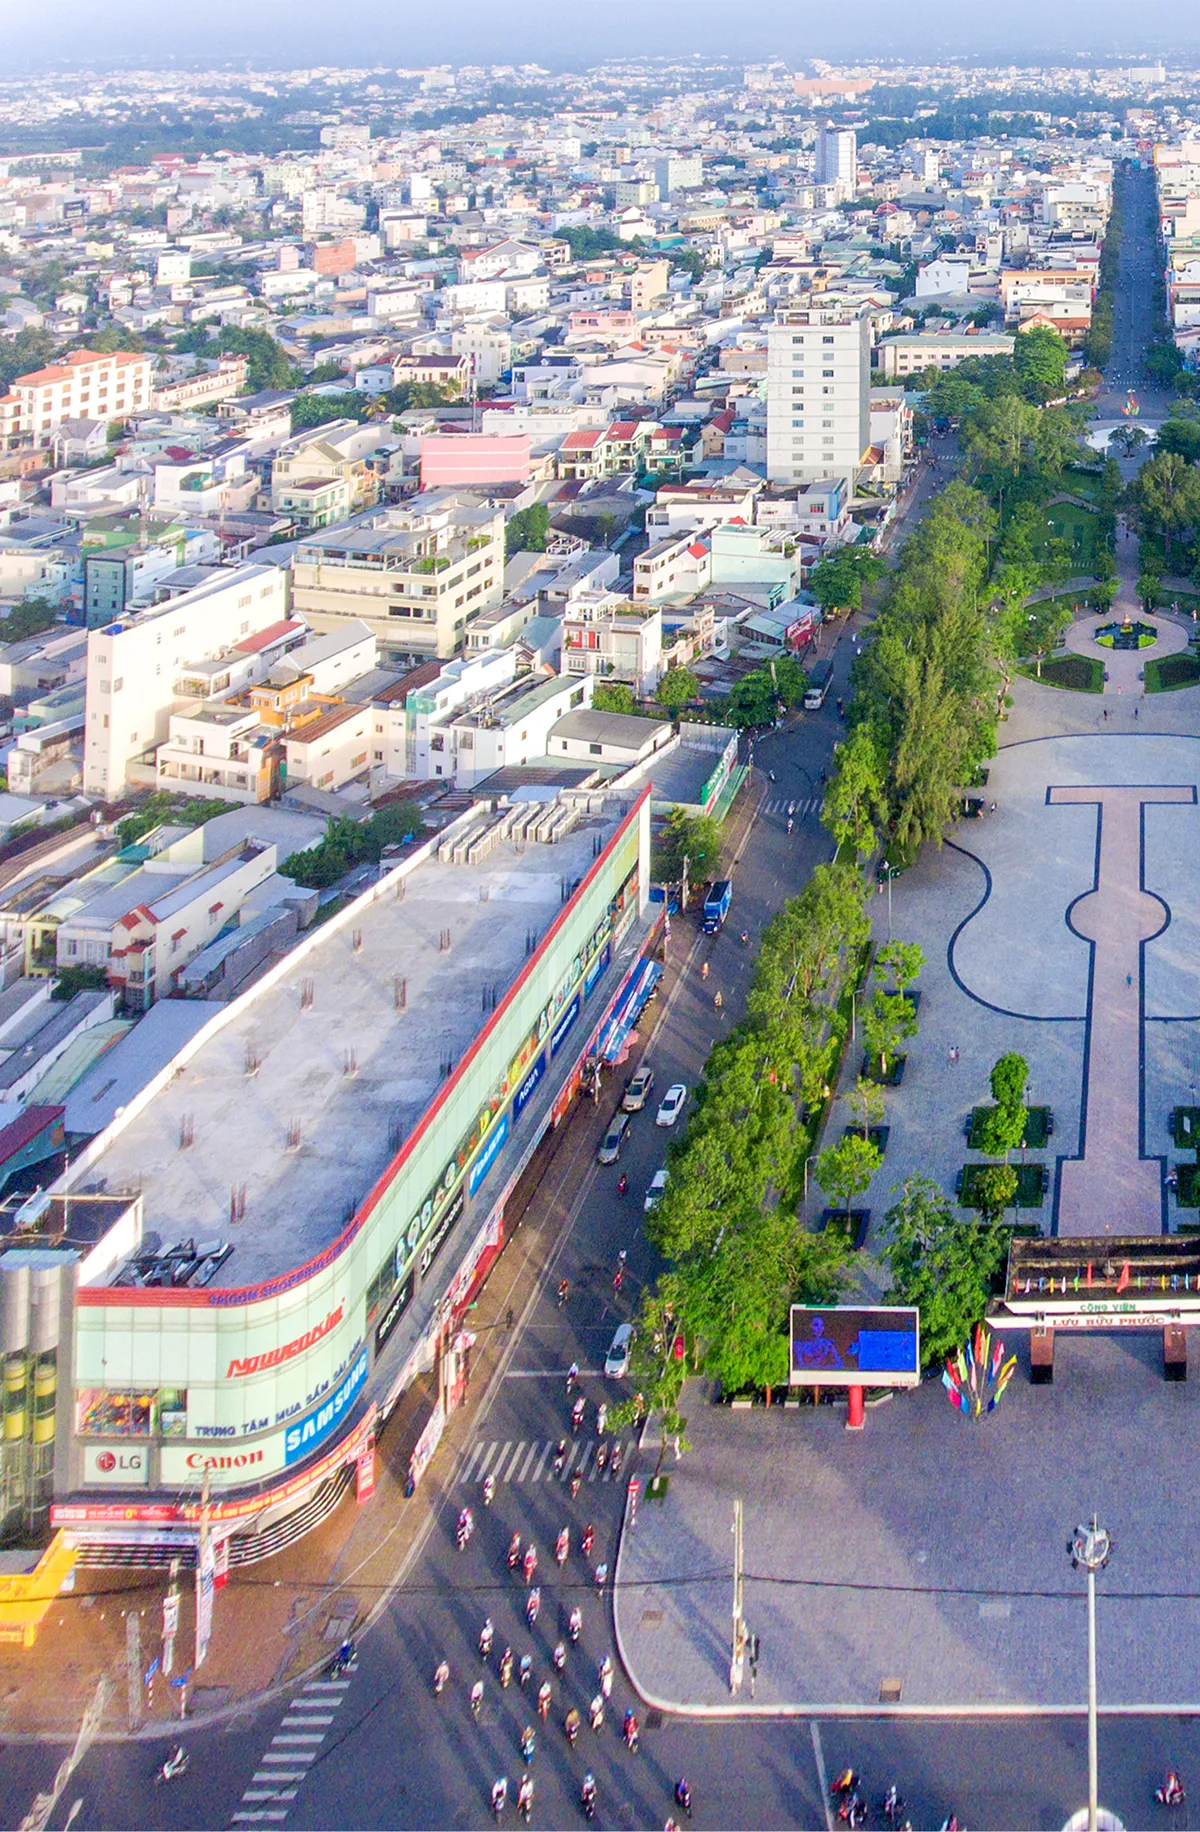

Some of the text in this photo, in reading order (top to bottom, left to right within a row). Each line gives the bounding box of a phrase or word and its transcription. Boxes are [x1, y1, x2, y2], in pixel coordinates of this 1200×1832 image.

[287, 1354, 367, 1451] SAMSUNG
[195, 1426, 236, 1436] TRUNG
[275, 1402, 301, 1423] MUA
[120, 1455, 141, 1469] LG
[186, 1450, 263, 1469] Canon
